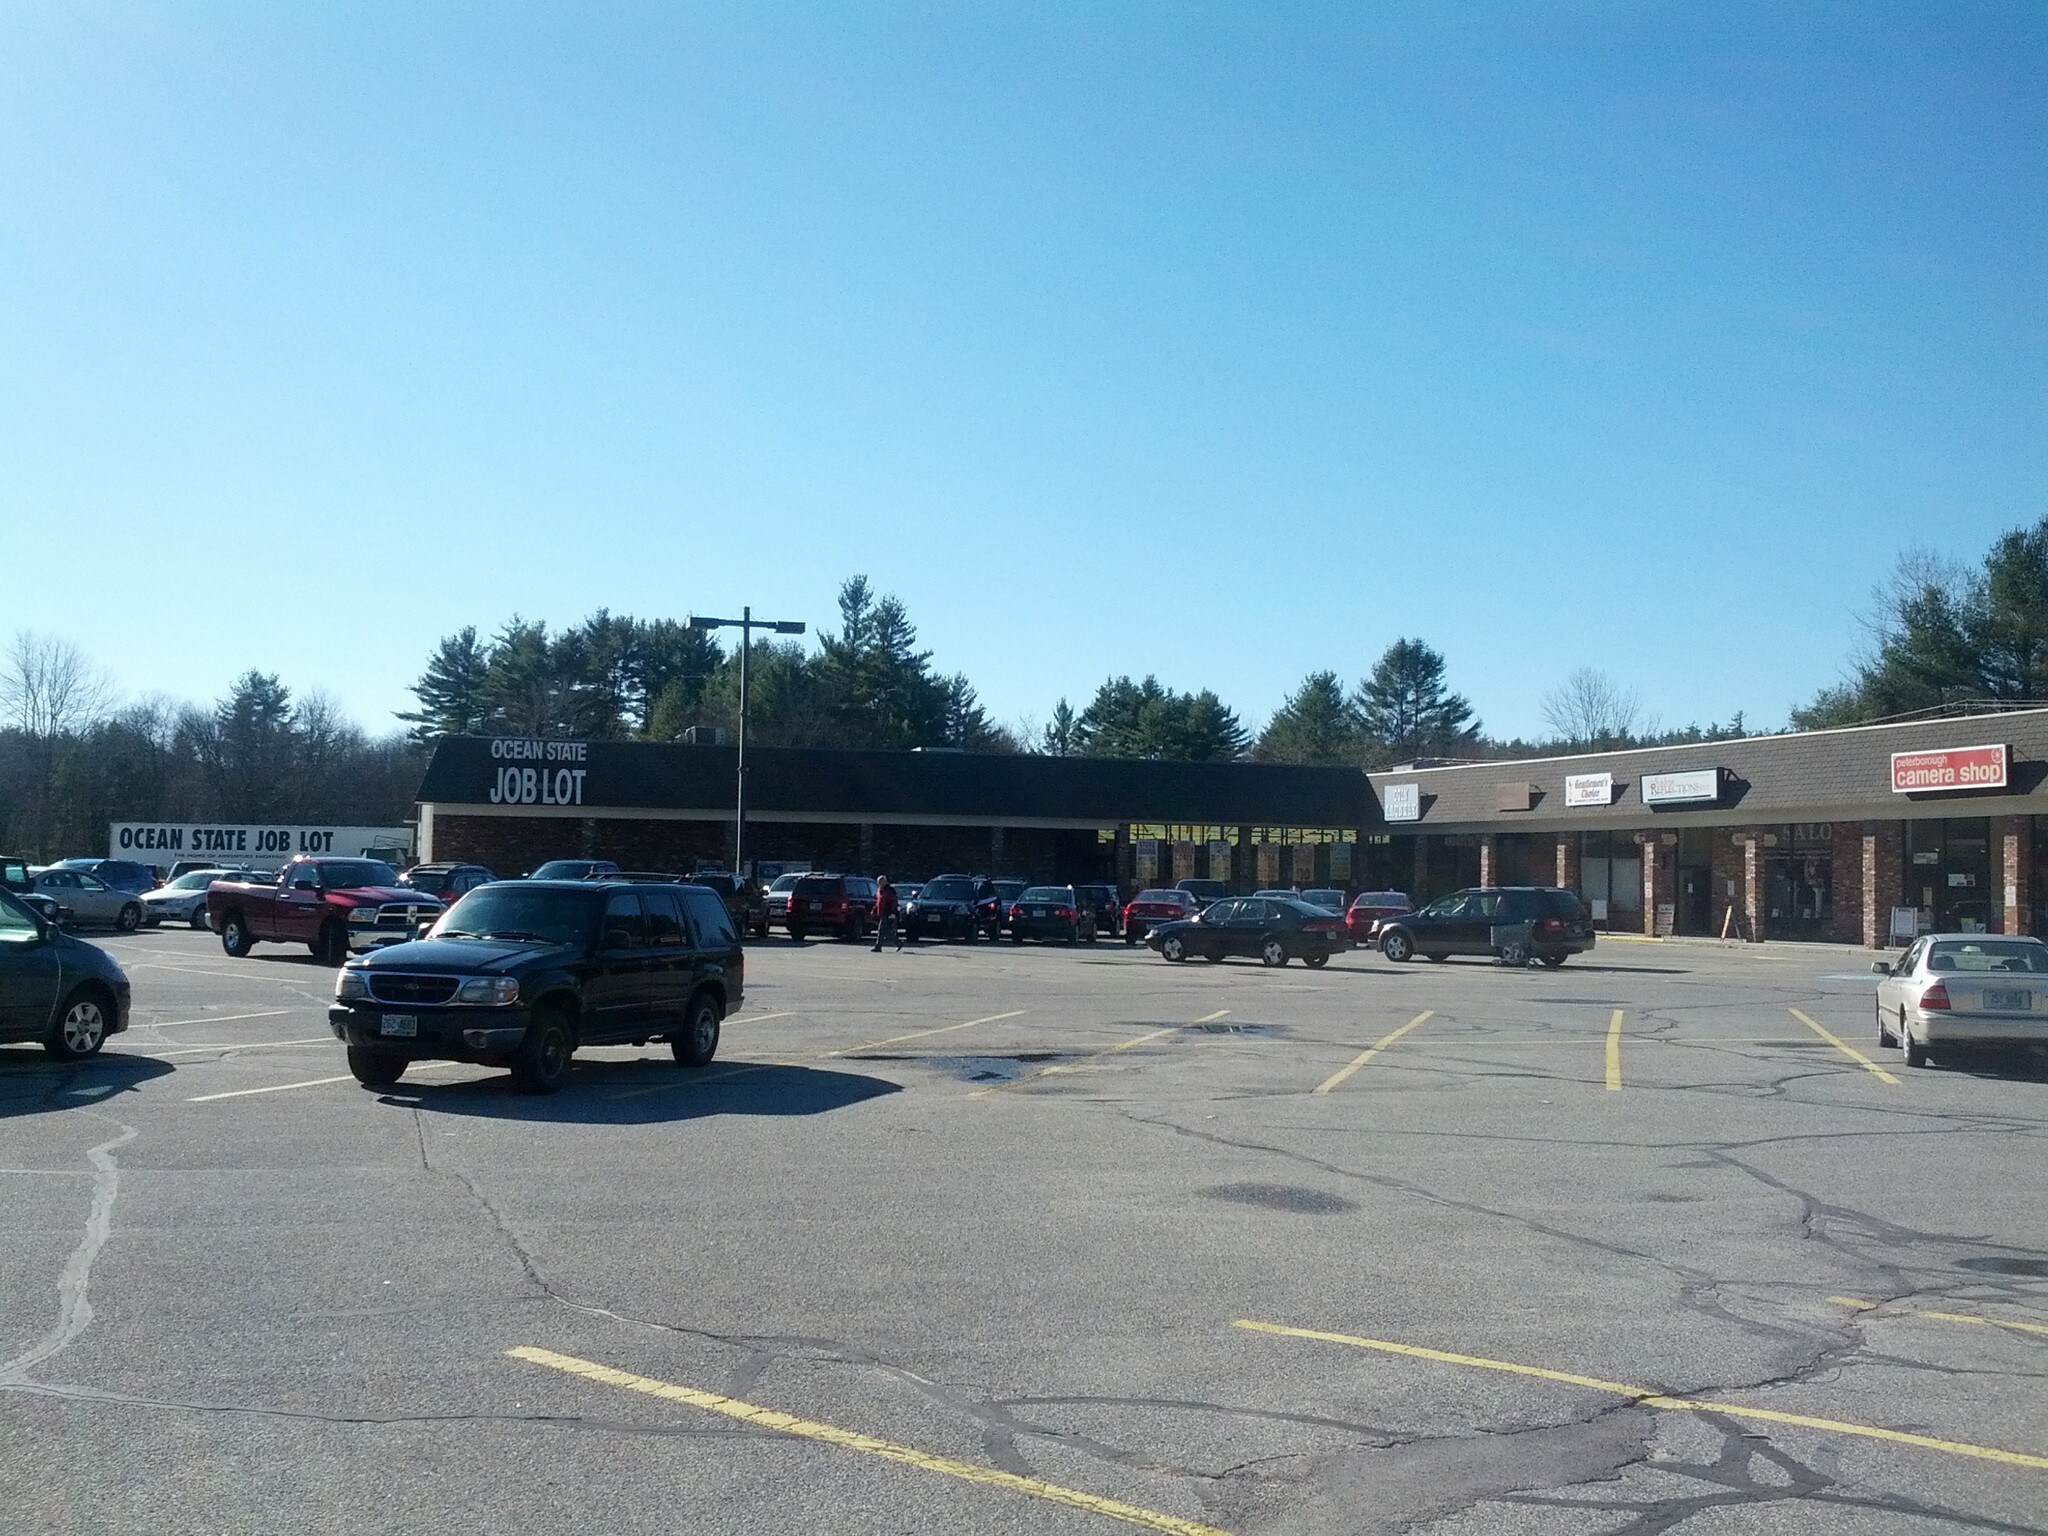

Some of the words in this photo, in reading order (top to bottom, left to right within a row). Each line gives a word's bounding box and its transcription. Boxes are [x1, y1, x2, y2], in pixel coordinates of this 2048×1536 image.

[491, 740, 543, 759] OCEAN
[547, 742, 587, 761] STATE
[1896, 755, 1948, 770] peterborough
[490, 767, 537, 803] JOB
[542, 768, 587, 805] LOT
[1897, 767, 1955, 786] camera
[1960, 762, 2001, 782] shop
[119, 827, 183, 849] OCEAN
[192, 829, 247, 851] STATE
[255, 830, 291, 852] JOB
[300, 831, 334, 852] LOT
